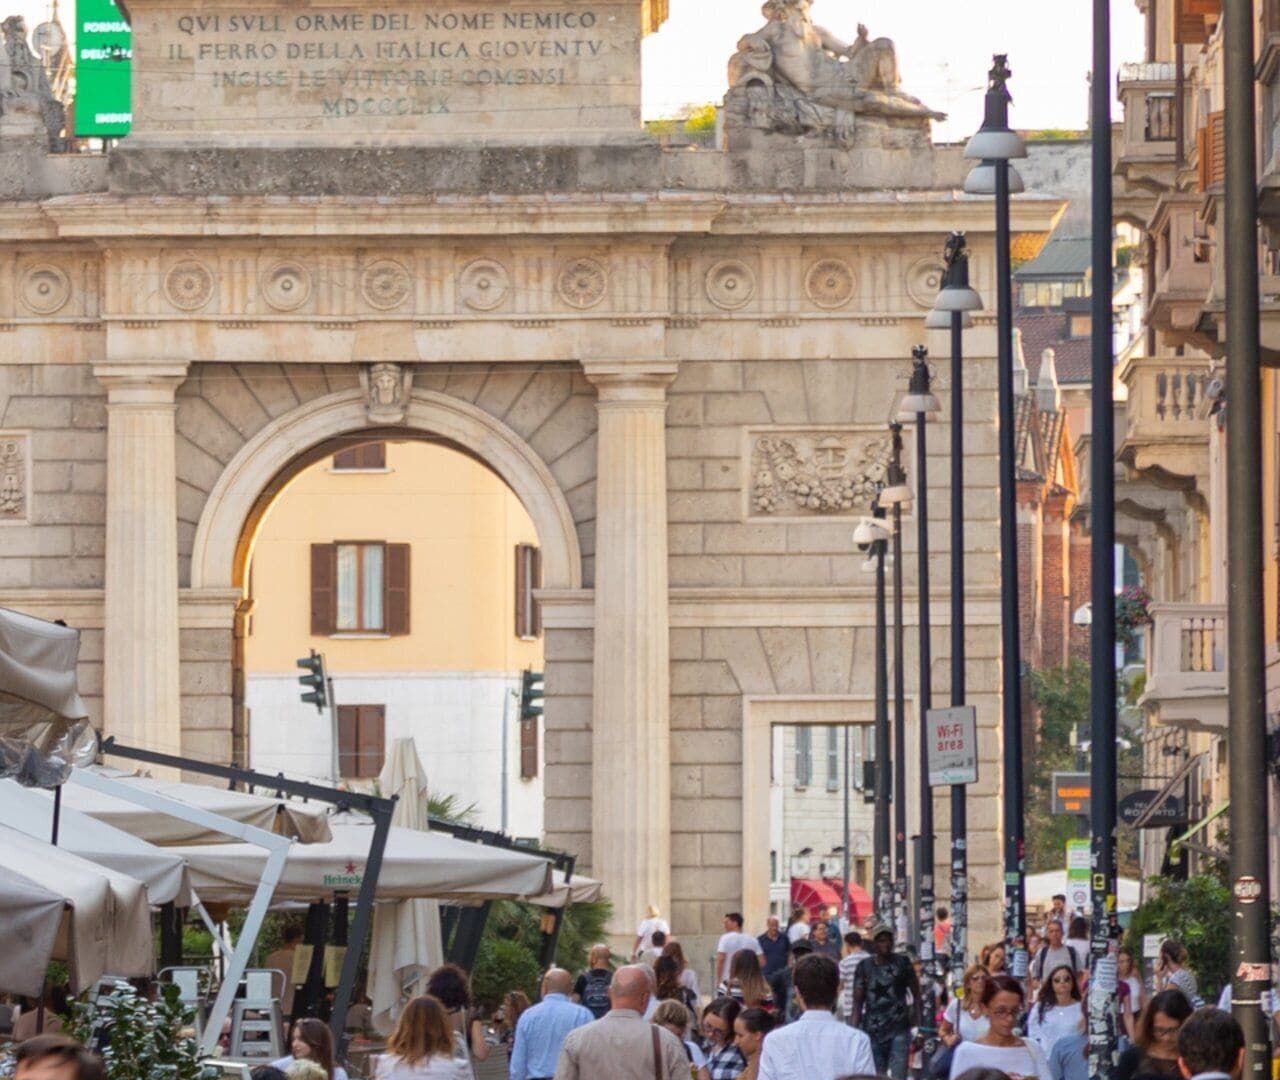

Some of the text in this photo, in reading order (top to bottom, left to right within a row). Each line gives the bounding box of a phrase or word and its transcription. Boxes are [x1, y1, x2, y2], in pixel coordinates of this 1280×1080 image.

[177, 15, 220, 36] QVI
[295, 14, 364, 32] ORME
[371, 13, 416, 32] DEL
[425, 12, 495, 31] NOME
[503, 11, 597, 30] NEMICO
[168, 39, 604, 61] IL FERRO DELLA ITALICA GIOVENTV
[211, 67, 566, 89] INCISE LE VITTORIE COMENSI
[321, 95, 451, 118] MDCCCLIX
[936, 723, 965, 739] Wi-Fi
[936, 739, 965, 752] area
[323, 873, 363, 886] Heinek
